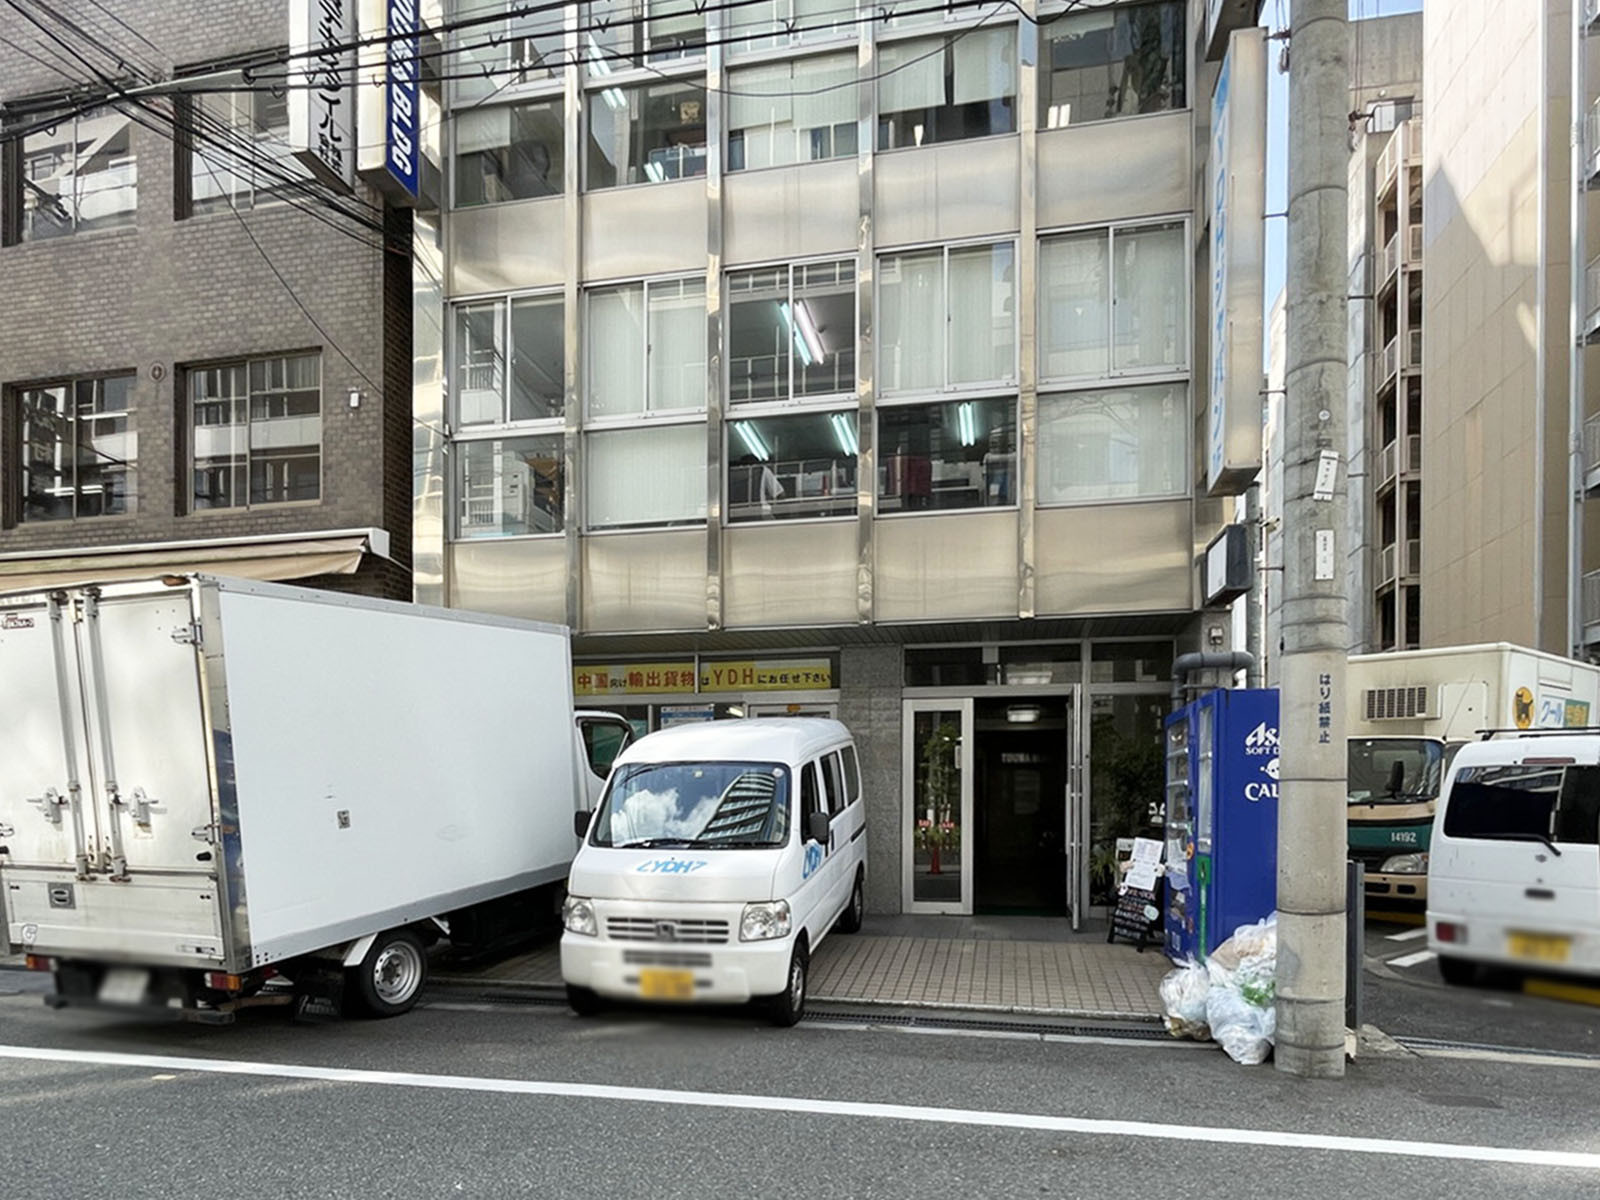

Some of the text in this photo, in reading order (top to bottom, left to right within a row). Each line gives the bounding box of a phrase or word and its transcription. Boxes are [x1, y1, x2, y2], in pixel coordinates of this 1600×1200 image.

[392, 83, 413, 176] BLDG
[1319, 674, 1331, 744] はり紙禁止
[1245, 747, 1270, 756] SOFT
